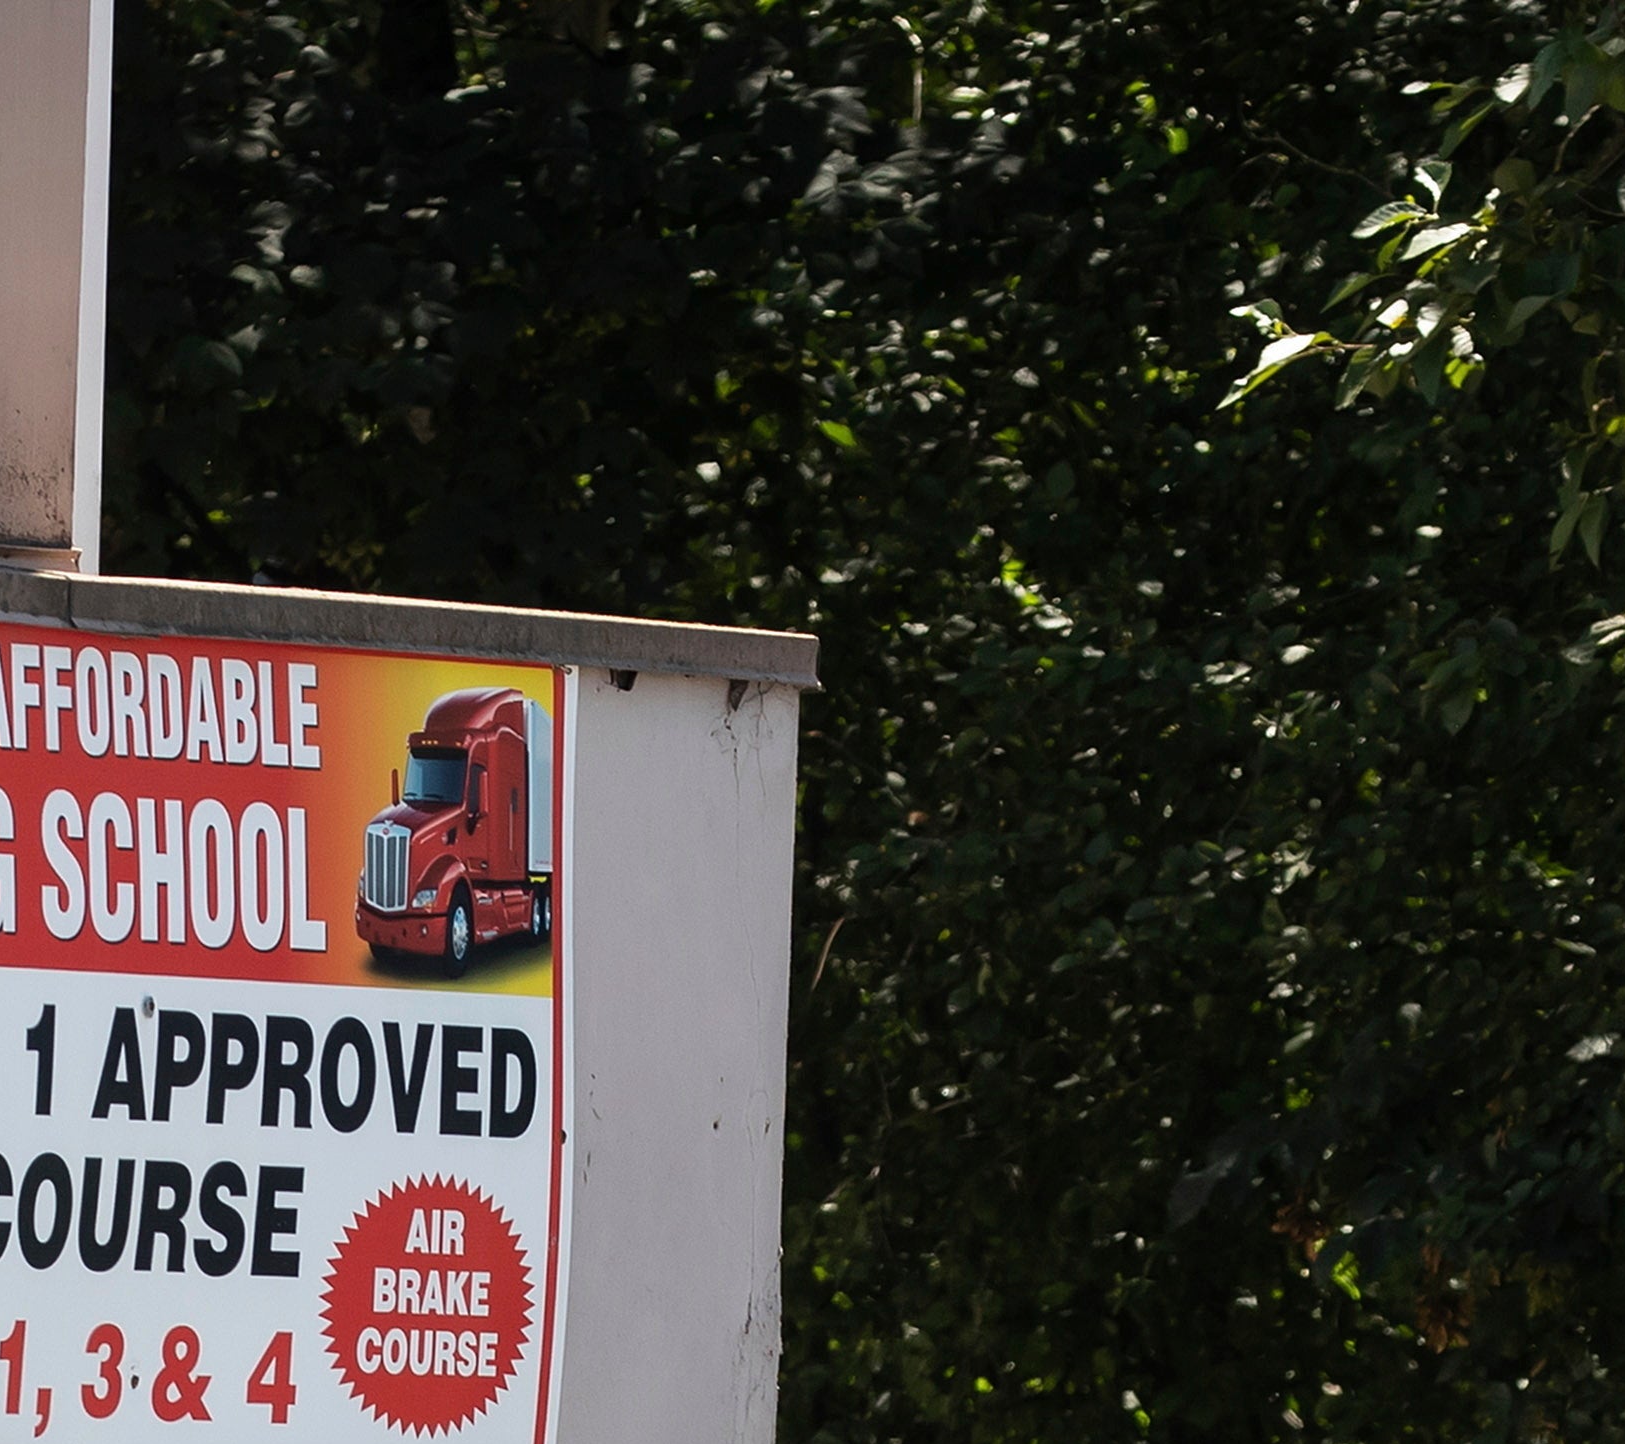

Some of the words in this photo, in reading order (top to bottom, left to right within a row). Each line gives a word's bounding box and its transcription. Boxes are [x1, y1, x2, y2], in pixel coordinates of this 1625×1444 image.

[41, 790, 327, 953] SCHOOL
[26, 1003, 57, 1117] 1
[91, 1006, 538, 1139] APPROVED
[405, 1207, 466, 1255] AIR
[371, 1267, 492, 1318] BRAKE
[81, 1322, 126, 1419] 3
[151, 1324, 213, 1422] &
[246, 1330, 297, 1424] 4
[354, 1330, 498, 1379] COURSE
